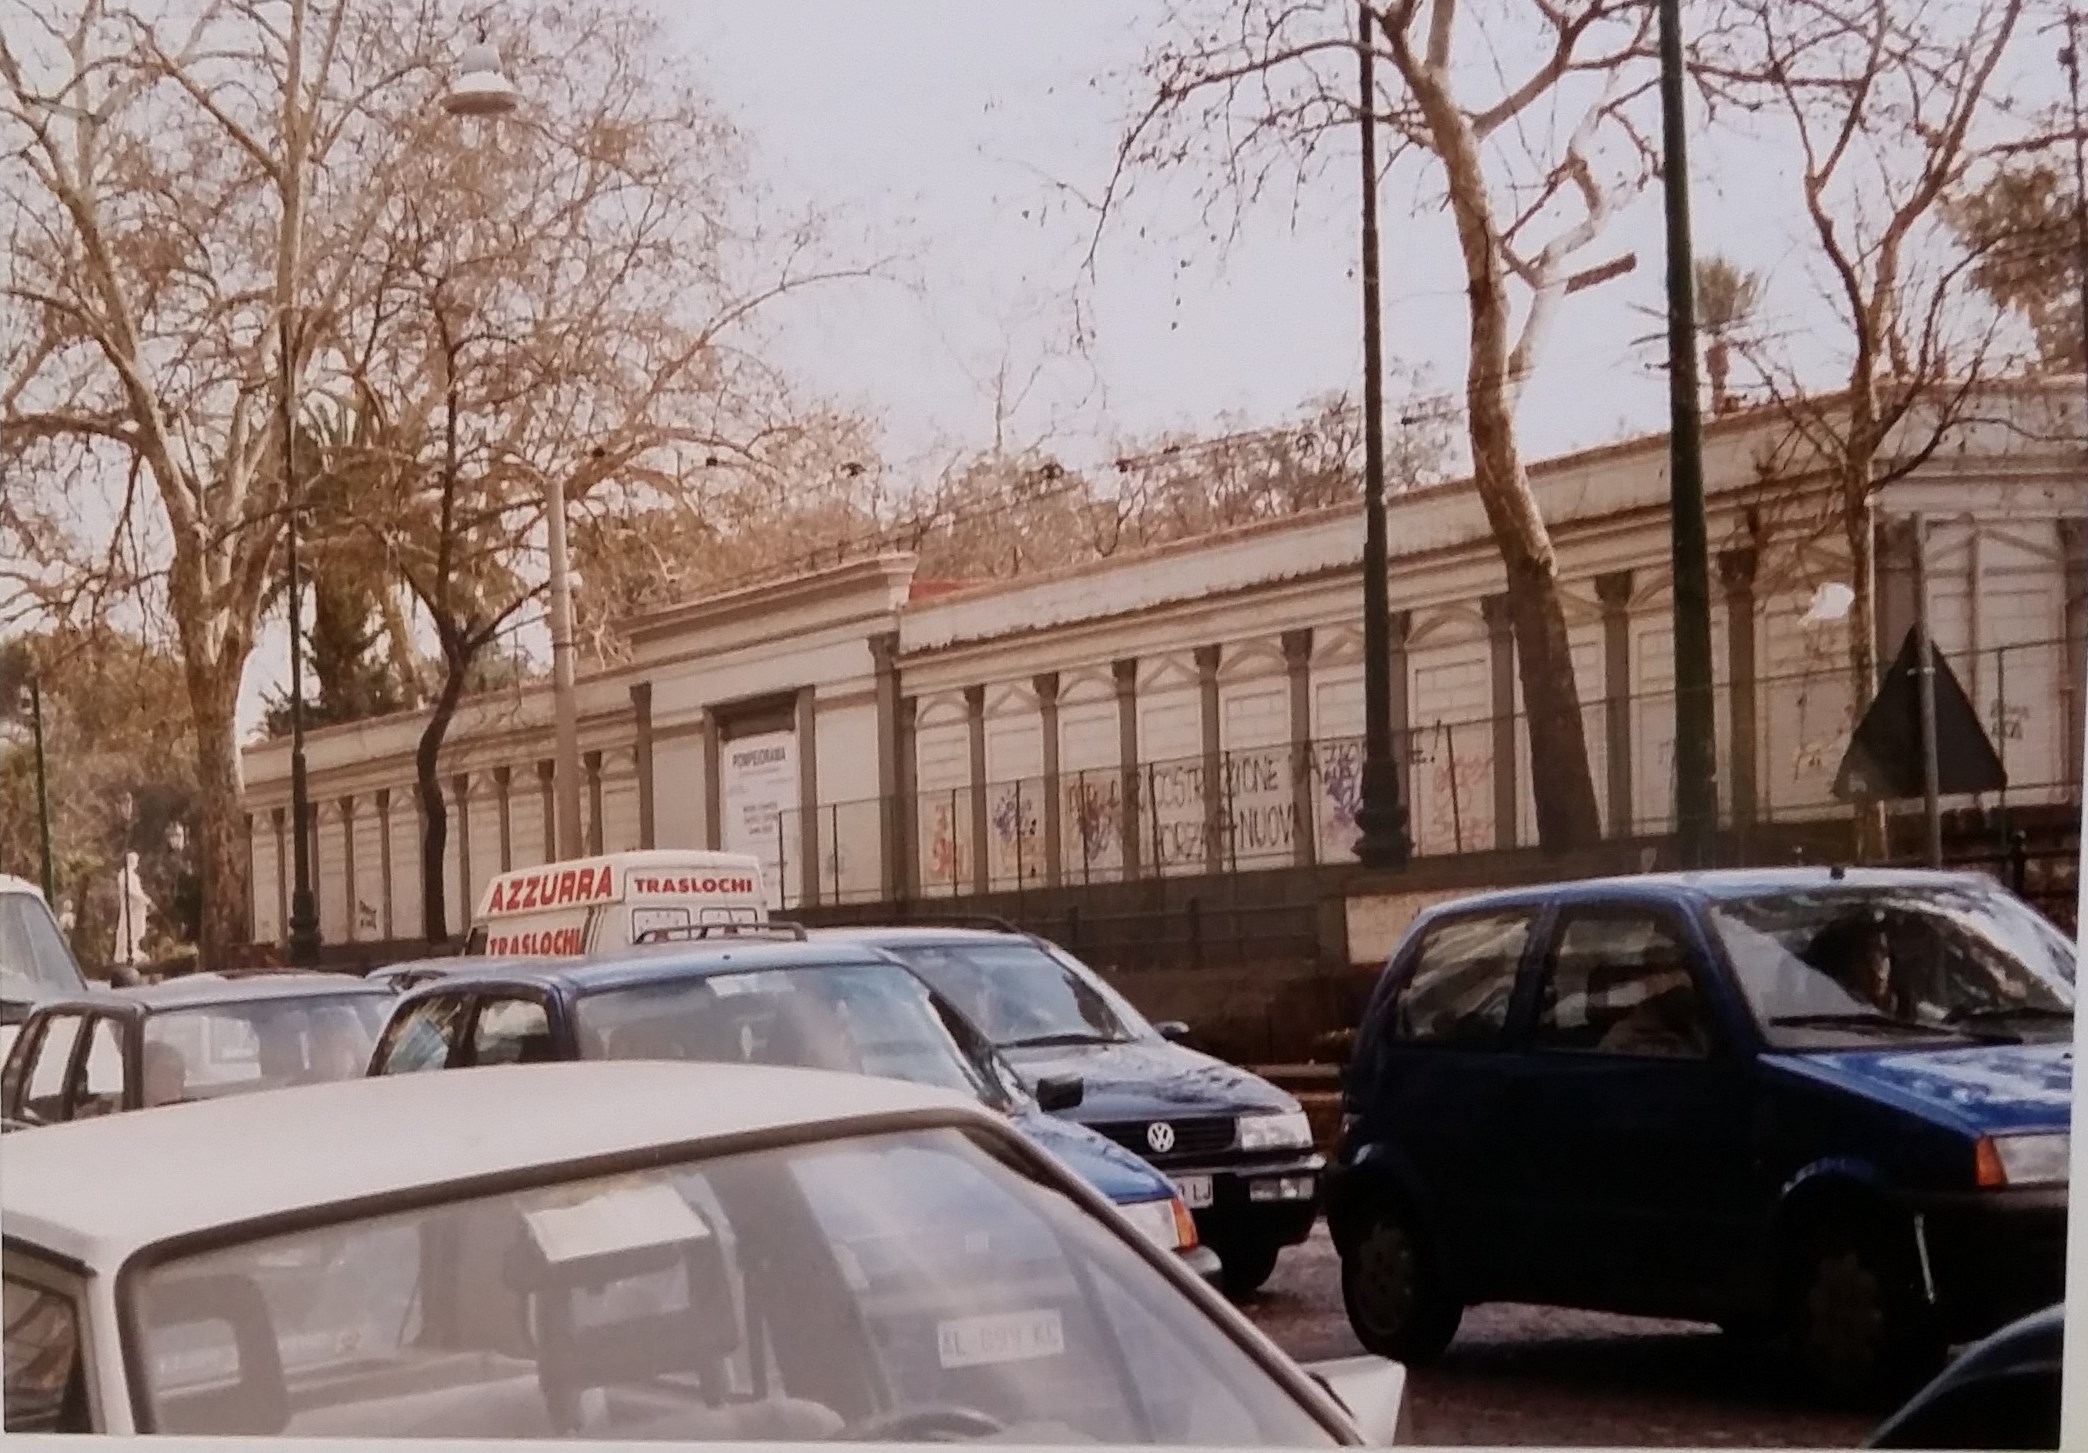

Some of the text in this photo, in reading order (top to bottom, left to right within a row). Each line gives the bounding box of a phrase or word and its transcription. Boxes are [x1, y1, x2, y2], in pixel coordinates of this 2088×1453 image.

[489, 865, 613, 912] AZZURRA
[635, 877, 753, 894] TRASLOCHI
[489, 927, 582, 956] TRASLOCHI
